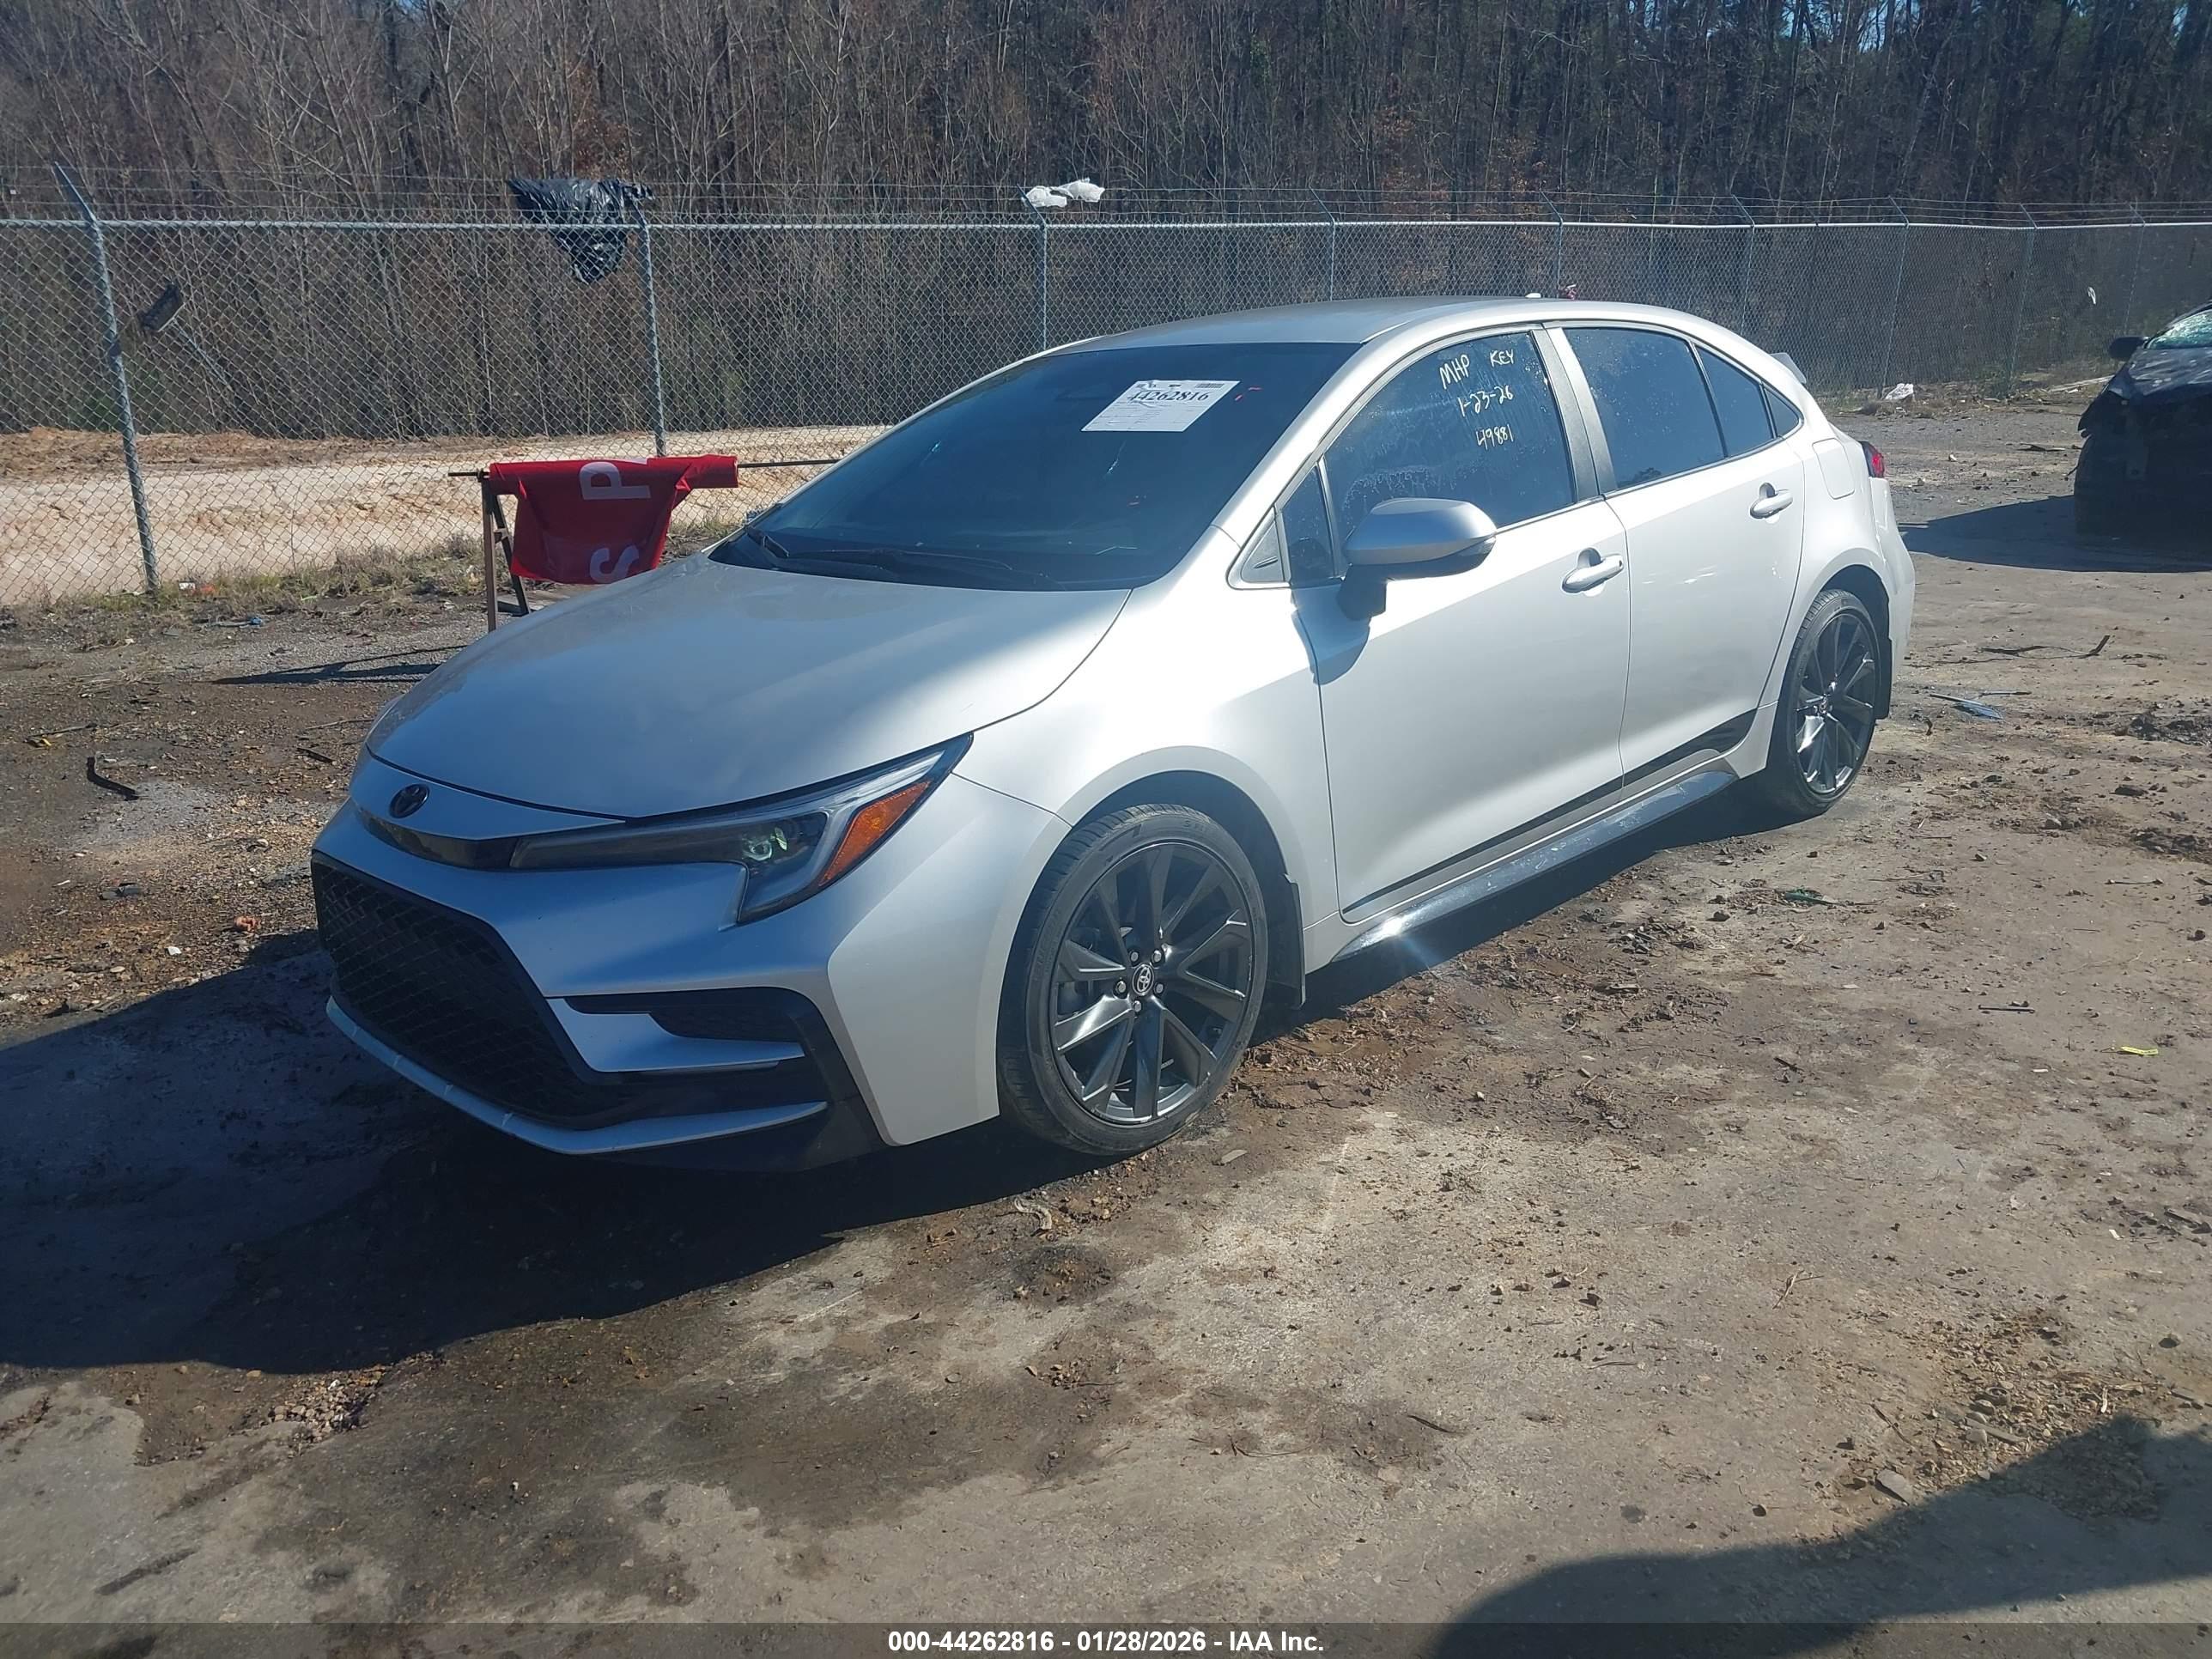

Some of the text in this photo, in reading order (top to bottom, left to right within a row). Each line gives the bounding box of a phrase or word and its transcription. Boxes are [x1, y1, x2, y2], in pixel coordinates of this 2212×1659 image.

[1439, 349, 1514, 390] MHP KEY
[1127, 391, 1210, 401] 44262816
[1457, 385, 1513, 416] 1-23-26
[1475, 423, 1514, 450] 49881
